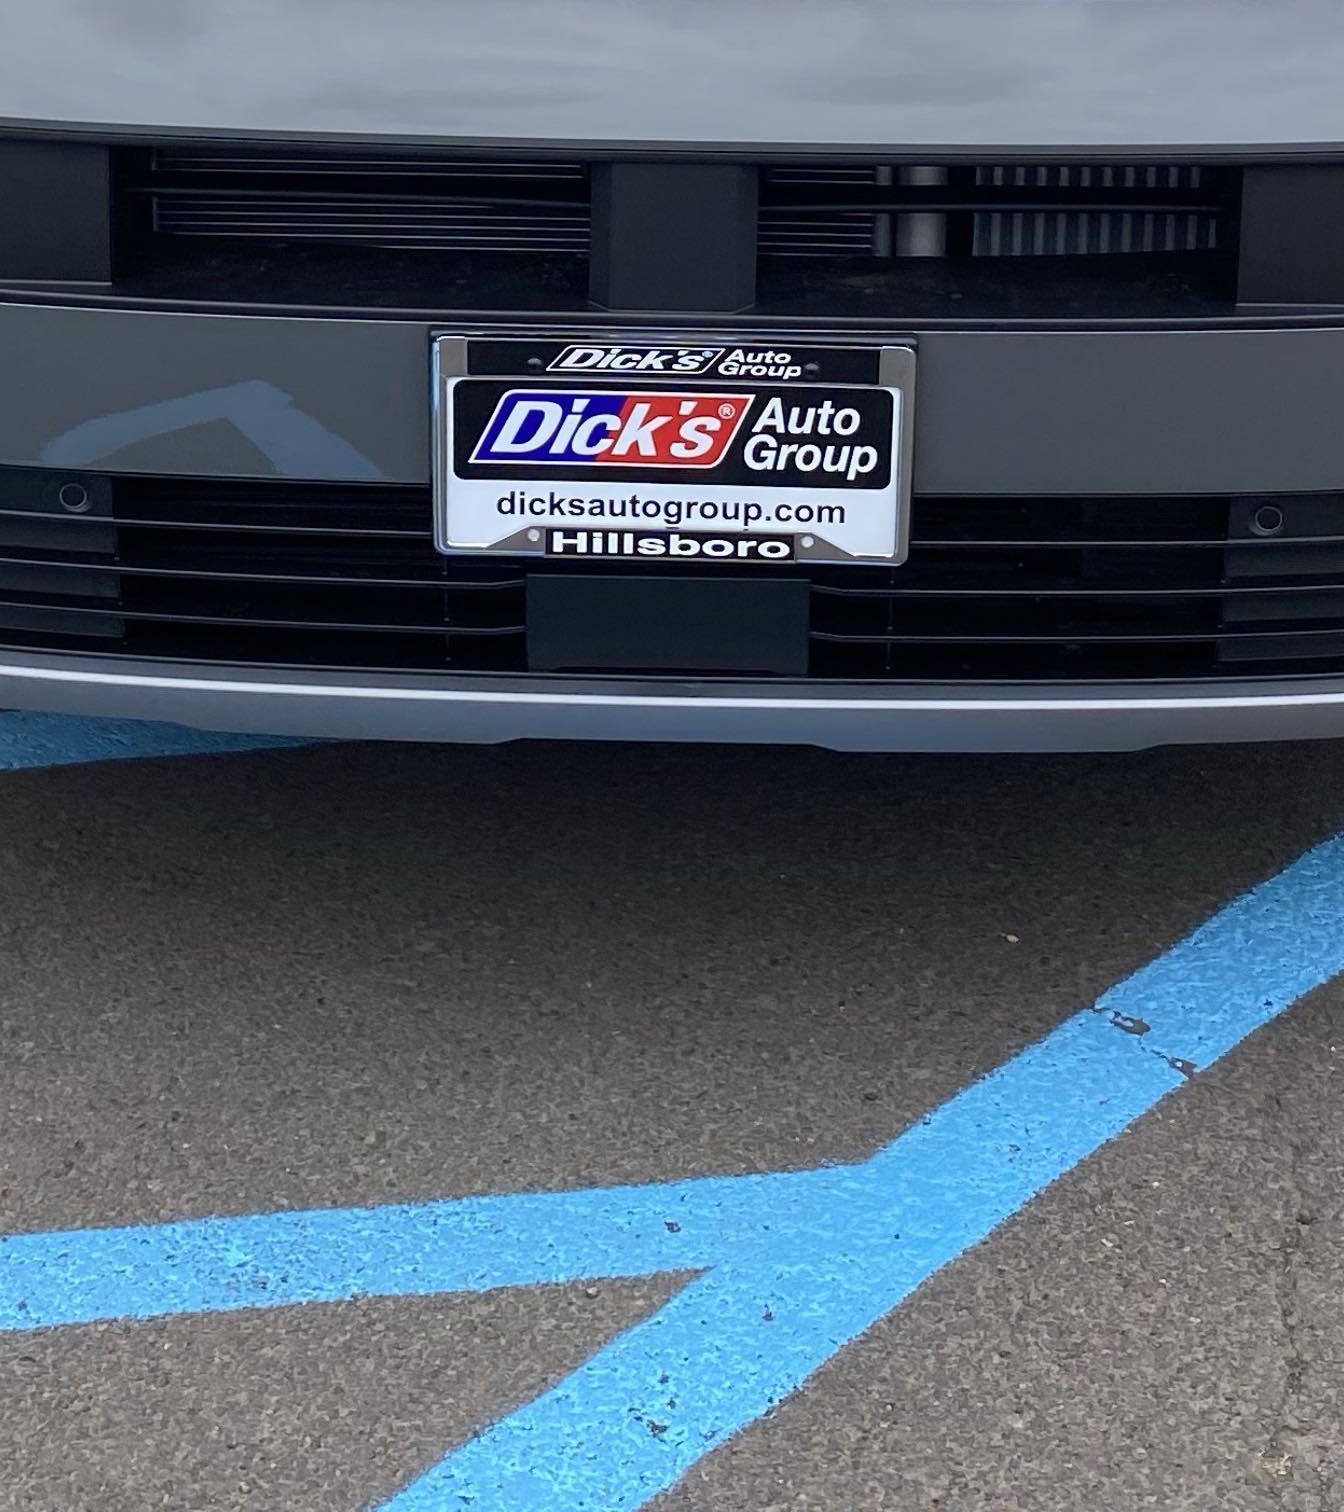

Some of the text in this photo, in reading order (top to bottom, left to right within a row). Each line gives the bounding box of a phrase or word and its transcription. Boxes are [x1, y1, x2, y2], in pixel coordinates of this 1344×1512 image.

[718, 362, 802, 380] Group
[724, 348, 792, 364] Auto
[490, 398, 722, 458] Dick's
[752, 398, 861, 436] Auto
[743, 438, 878, 481] Group
[496, 490, 846, 529] dicksautogroup.com
[552, 532, 792, 559] Hillsboro
